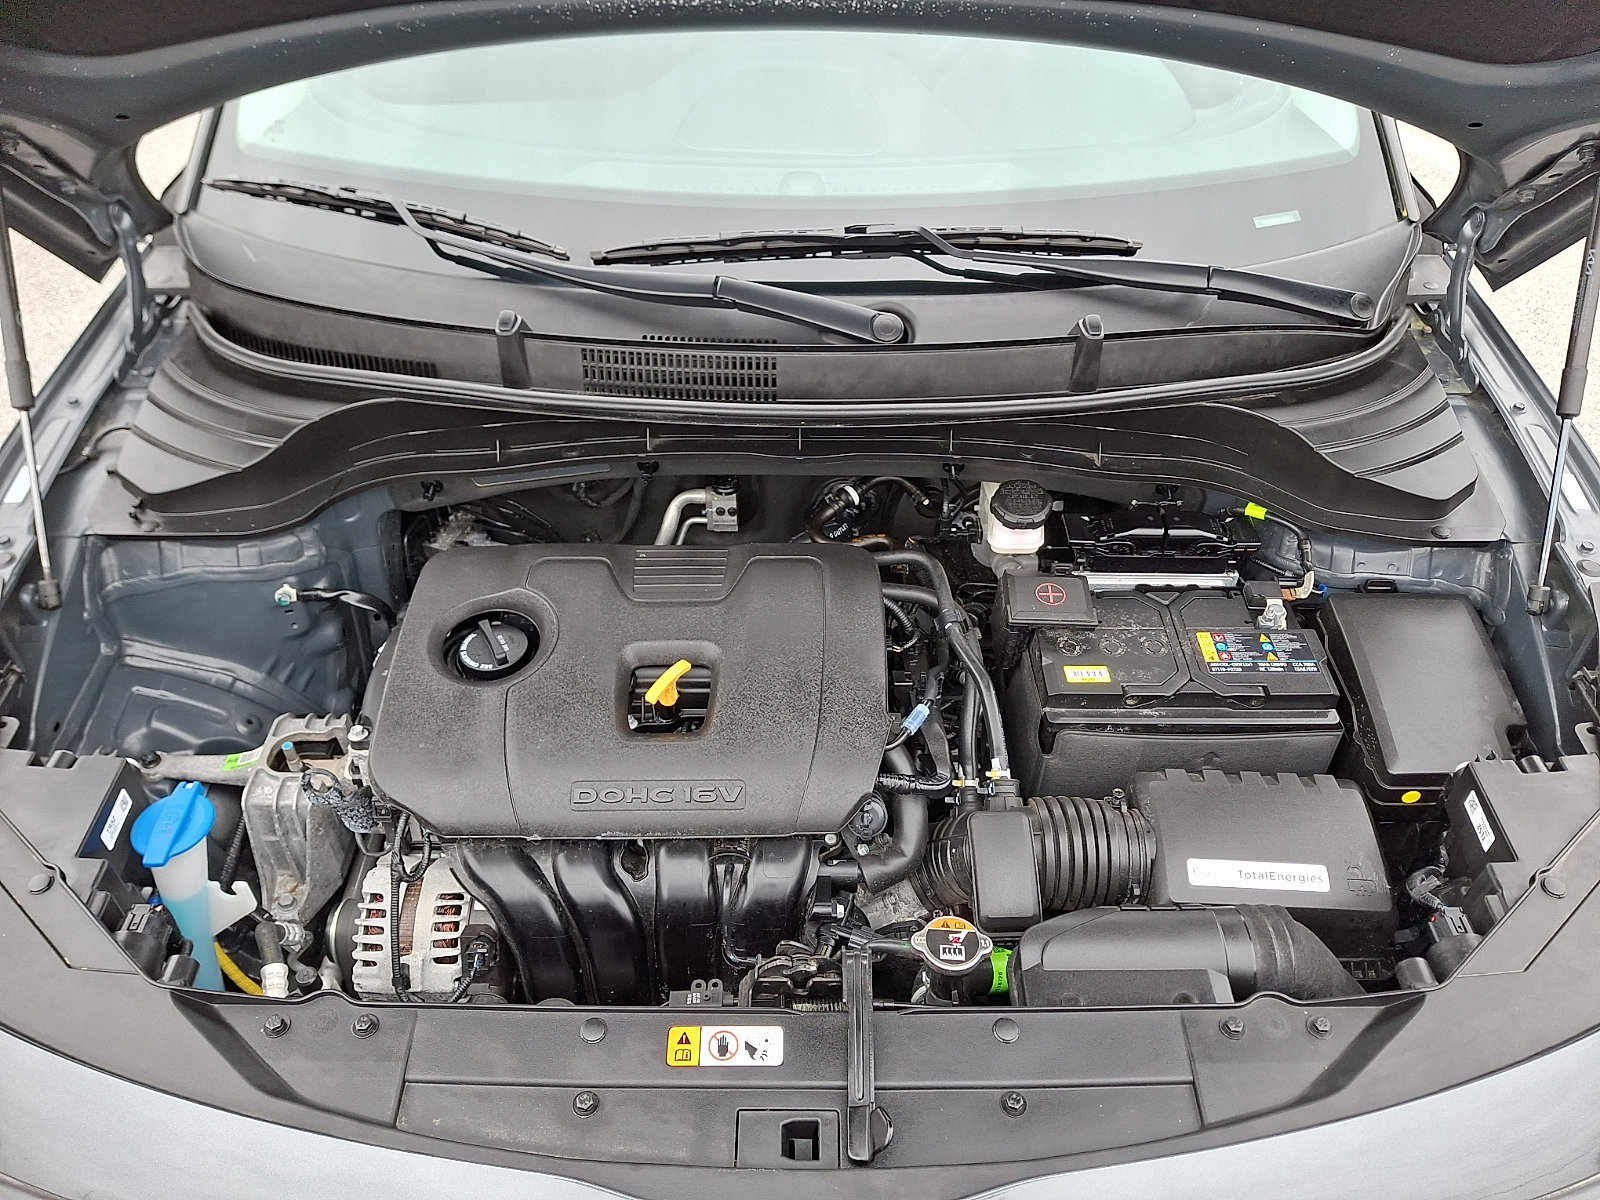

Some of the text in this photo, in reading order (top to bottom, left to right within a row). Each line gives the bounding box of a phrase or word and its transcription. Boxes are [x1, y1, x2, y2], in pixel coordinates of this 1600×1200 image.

[573, 786, 744, 804] DOHC 16V
[1237, 869, 1324, 884] TotalEnergies
